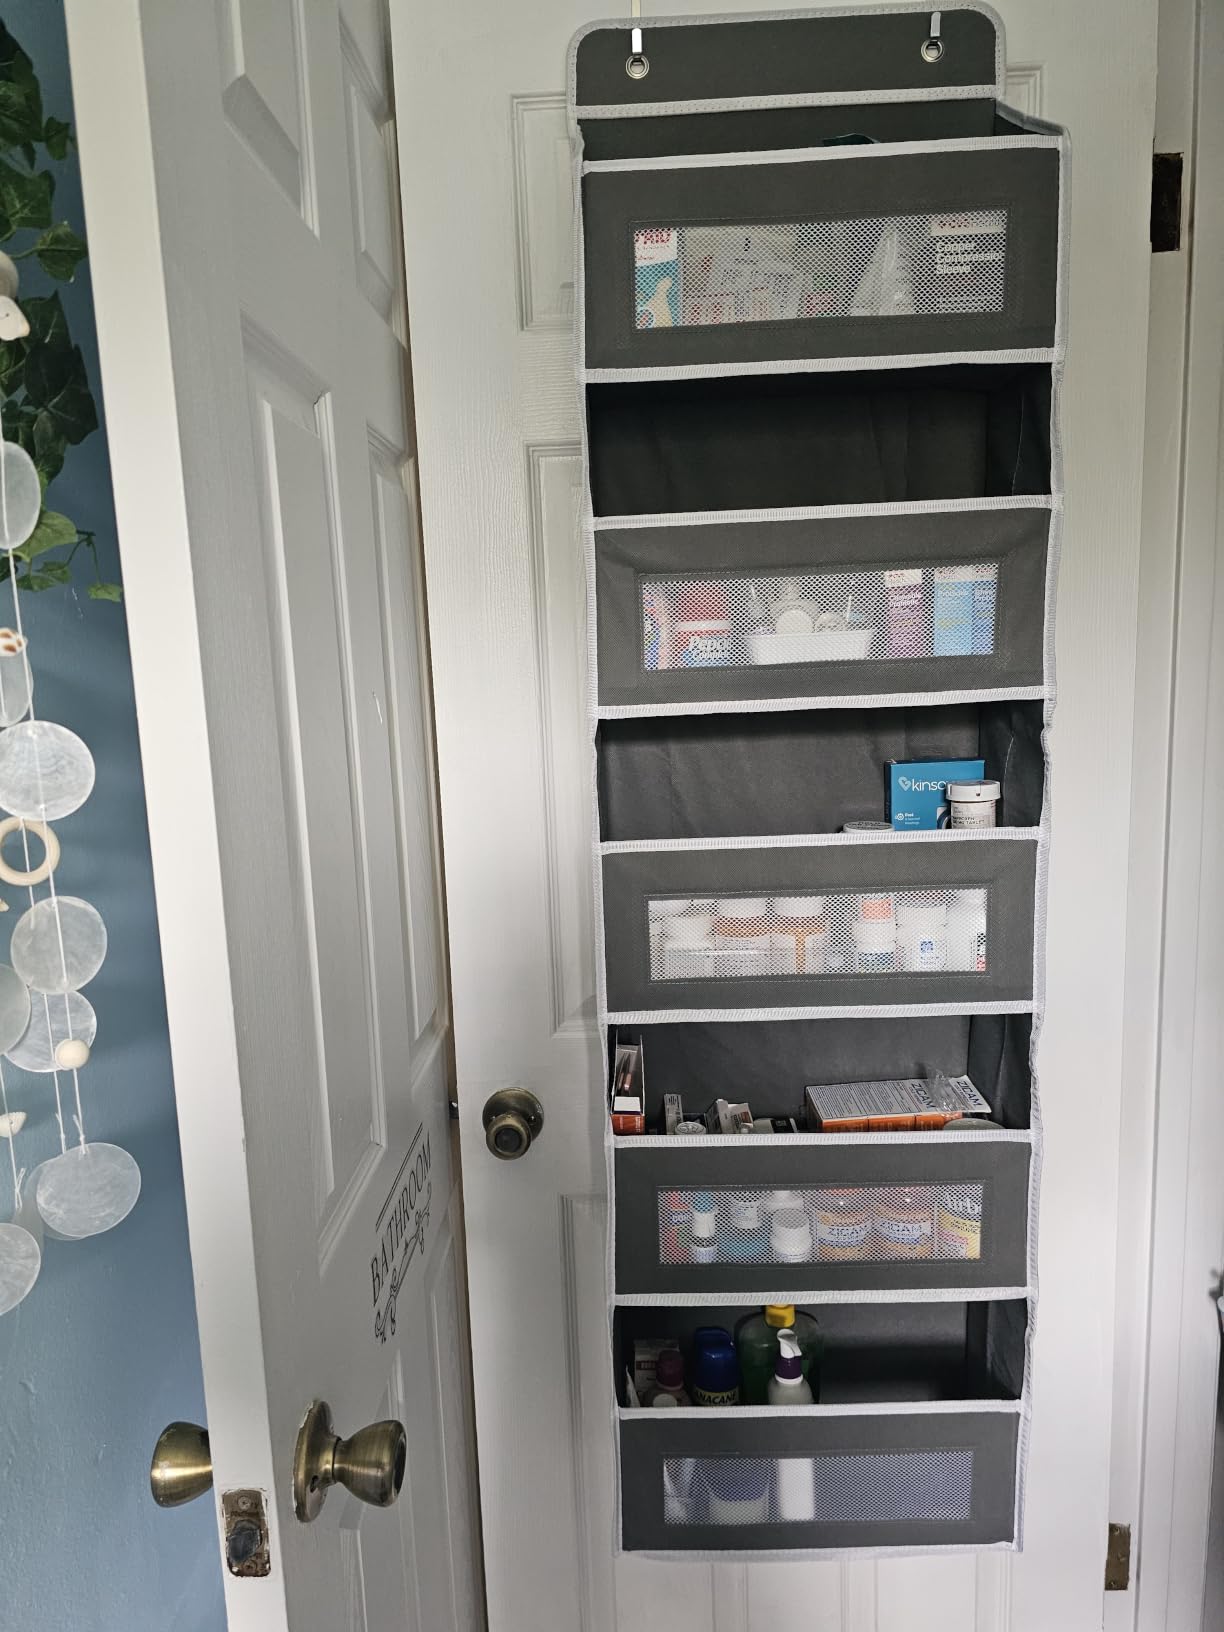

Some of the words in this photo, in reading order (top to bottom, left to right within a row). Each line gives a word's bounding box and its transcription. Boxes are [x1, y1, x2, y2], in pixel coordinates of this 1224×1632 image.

[936, 242, 975, 254] Copper
[936, 264, 971, 275] Sleeve
[911, 1083, 937, 1109] ZICAM
[956, 1080, 983, 1106] ZICAM
[371, 1132, 432, 1307] BATHROOM
